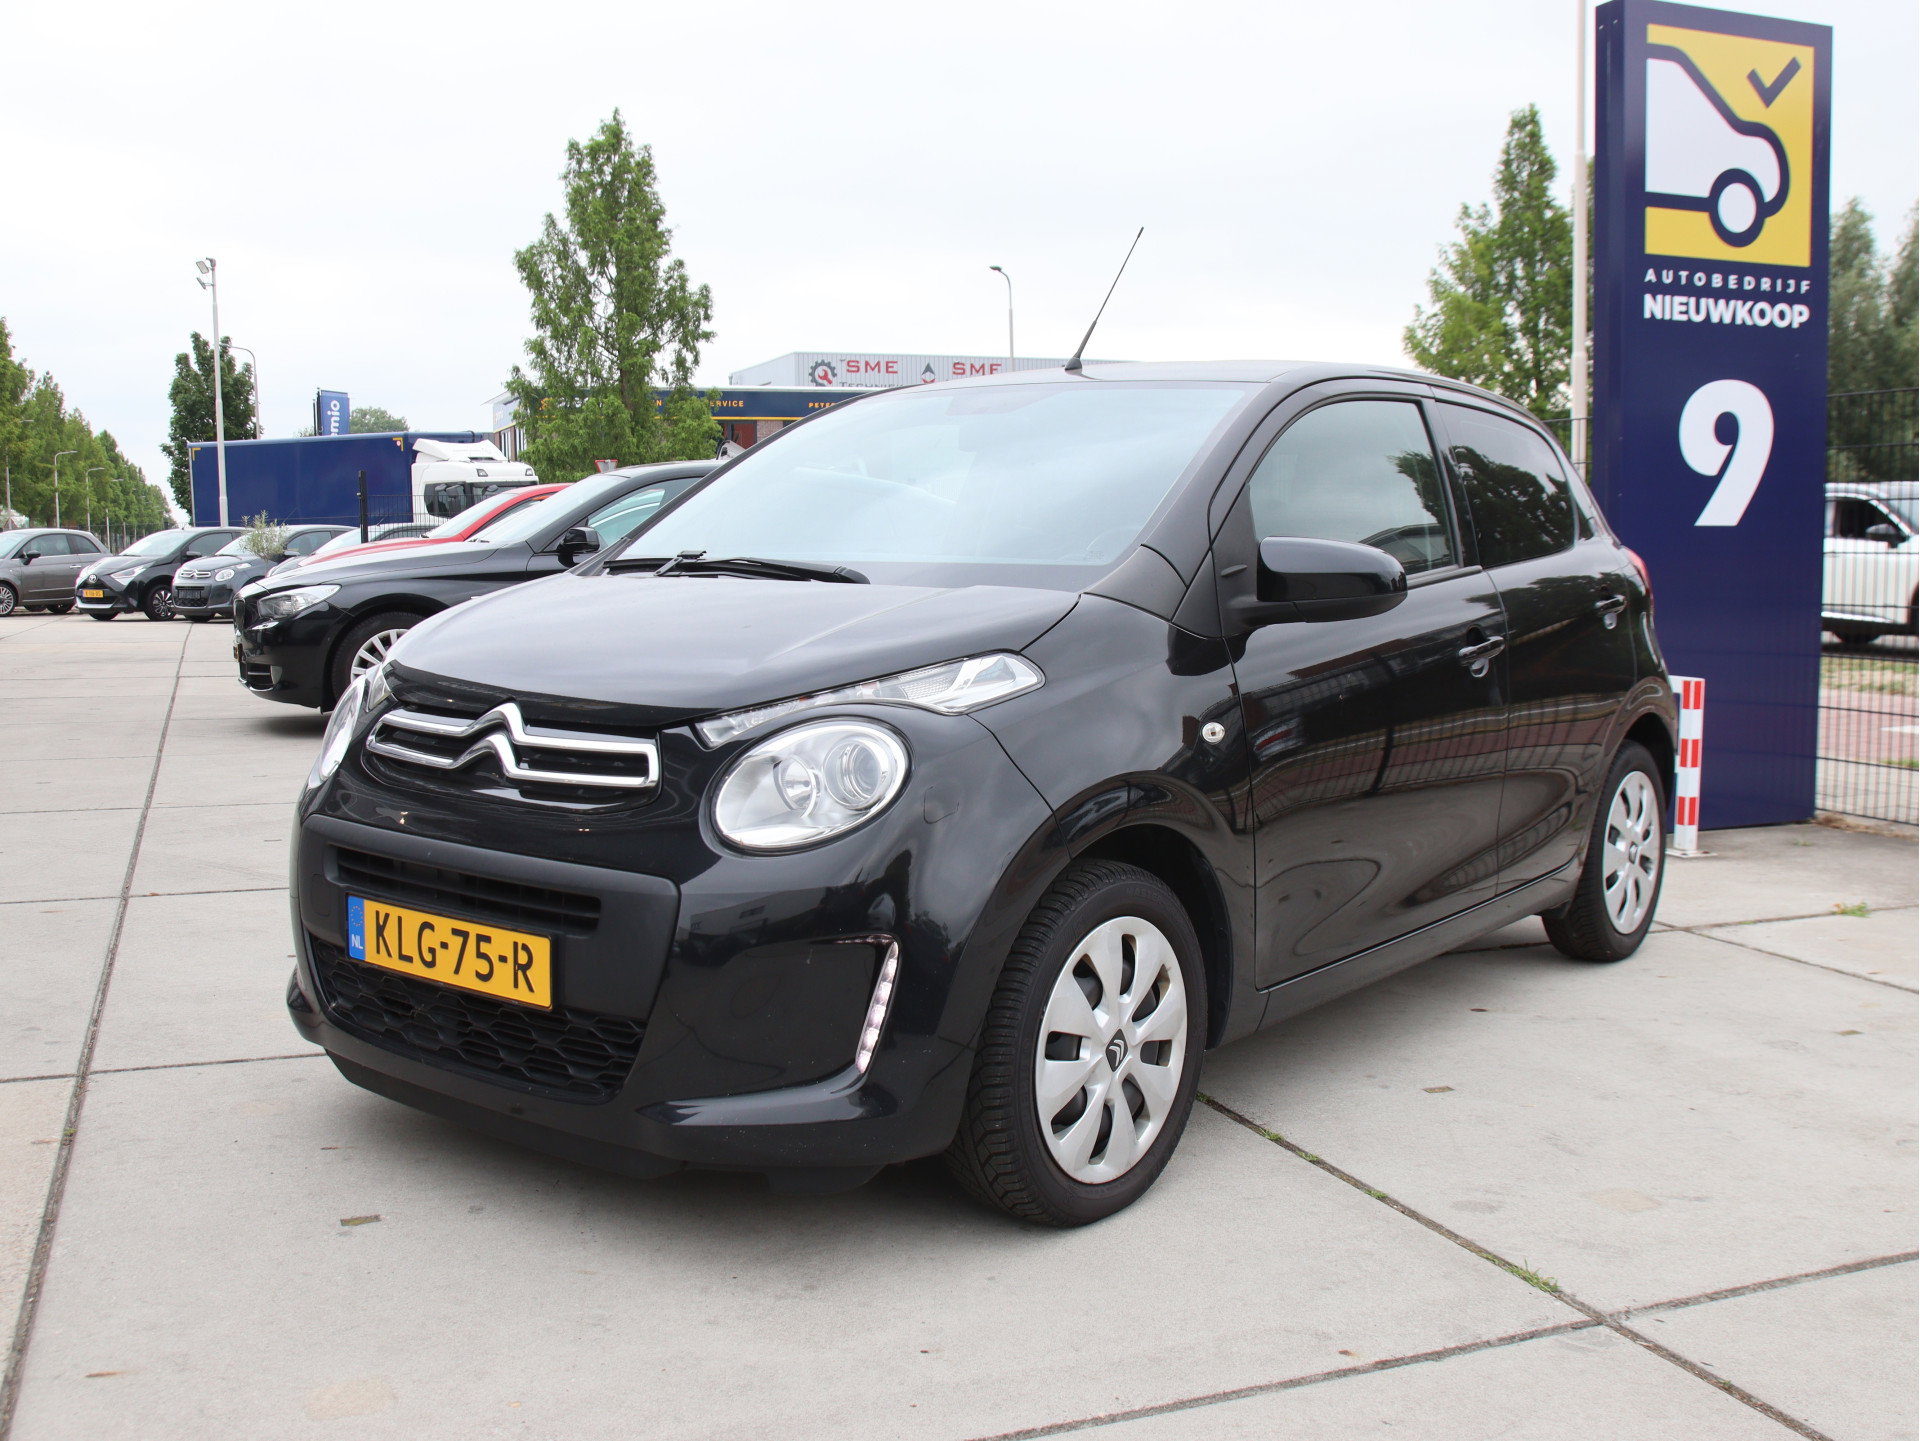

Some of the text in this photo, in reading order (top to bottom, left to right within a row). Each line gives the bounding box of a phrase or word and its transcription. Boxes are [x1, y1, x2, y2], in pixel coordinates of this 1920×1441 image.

[1644, 268, 1810, 294] AUTOBEDRIJF
[1643, 293, 1810, 329] NIEUWKOOP
[846, 360, 899, 374] SME
[1678, 378, 1775, 527] 9
[351, 910, 535, 993] NL KLG-75-R
